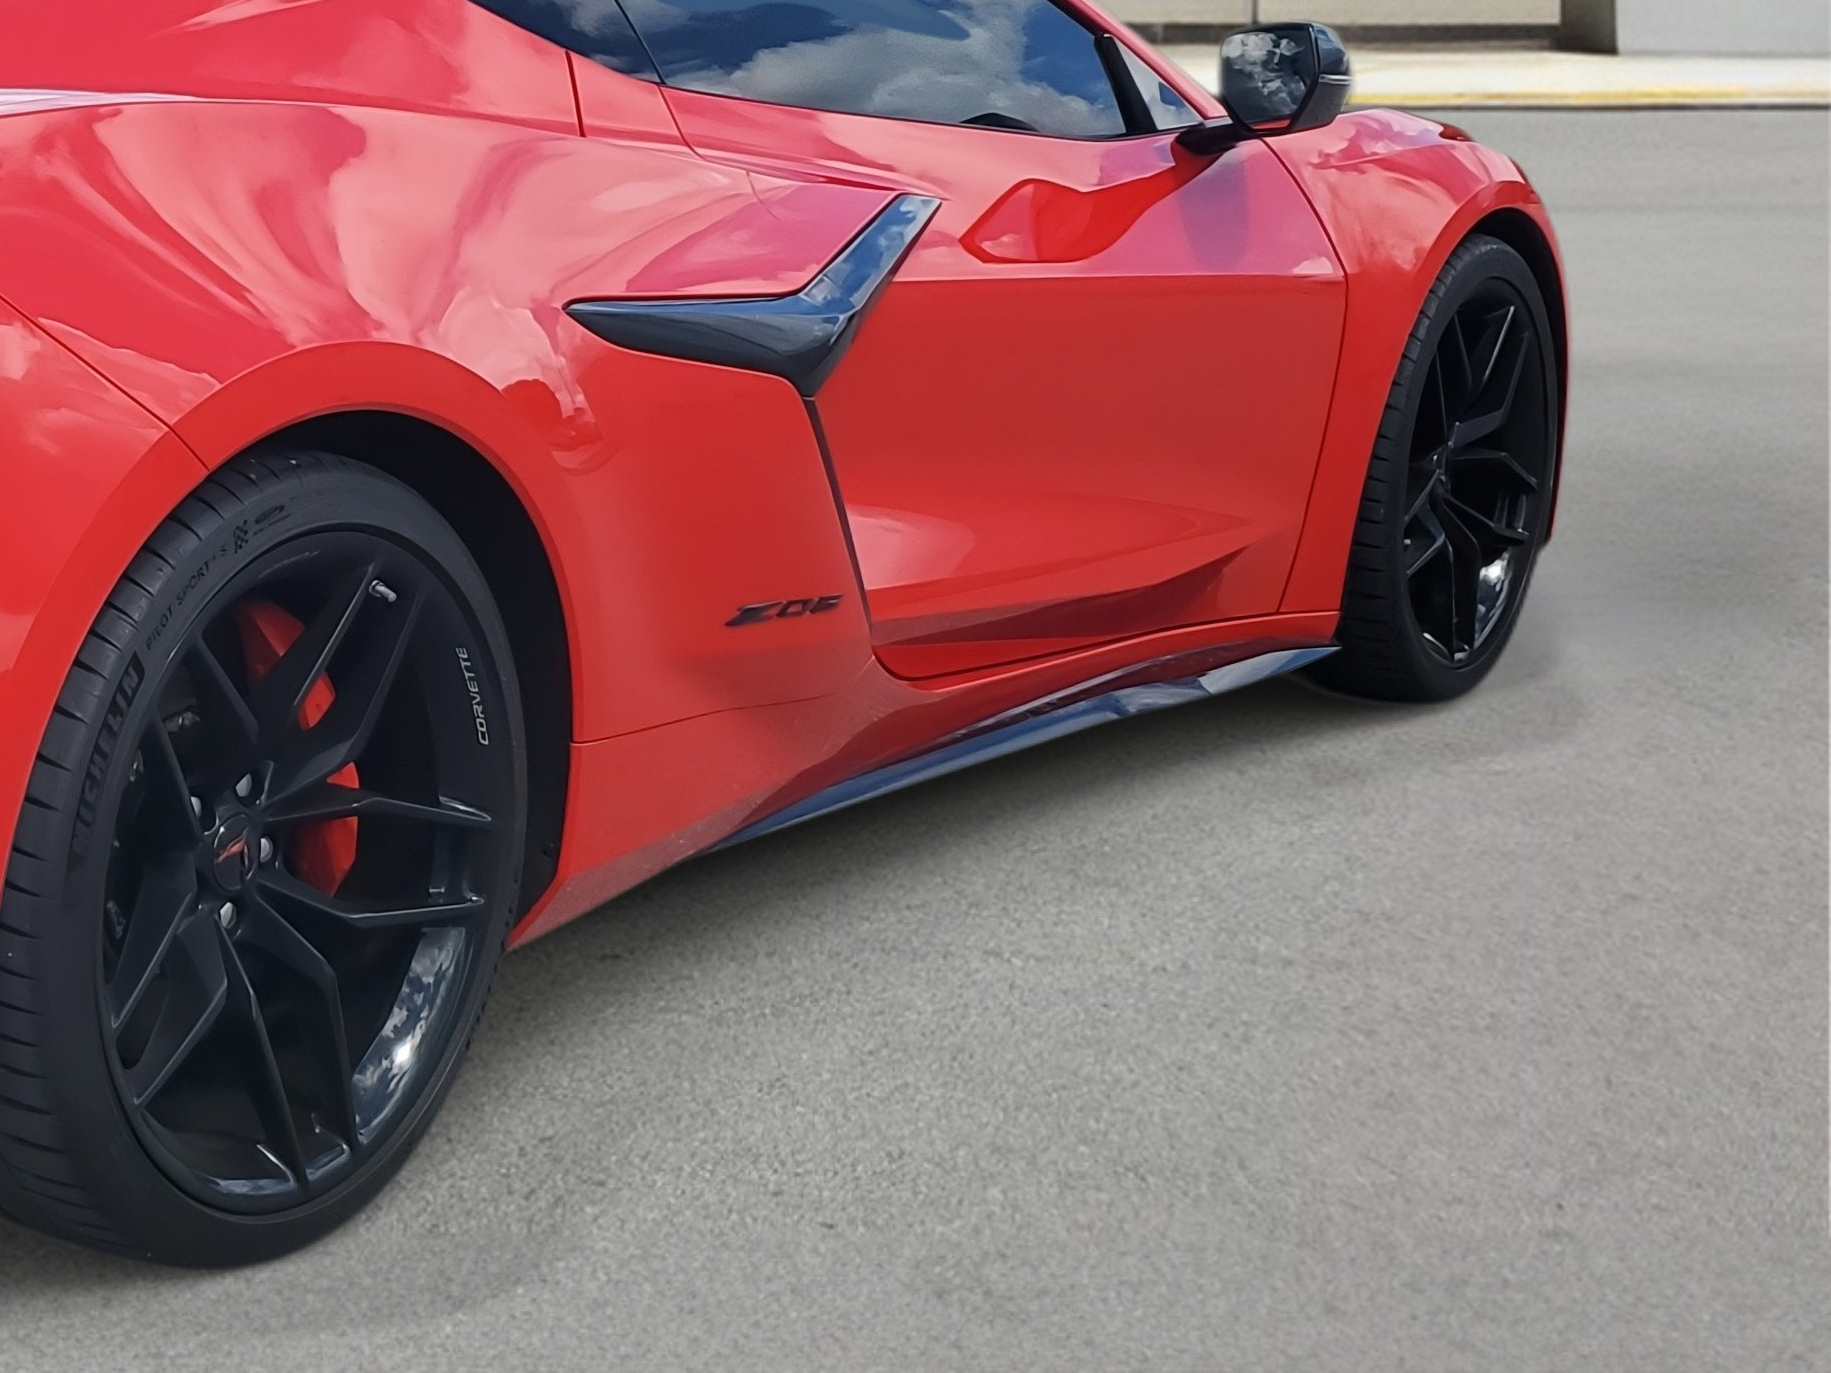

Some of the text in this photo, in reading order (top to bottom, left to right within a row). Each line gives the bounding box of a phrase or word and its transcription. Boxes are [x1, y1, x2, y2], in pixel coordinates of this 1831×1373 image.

[725, 594, 843, 626] Z06
[455, 647, 489, 745] CORVETTE
[71, 665, 139, 857] MICHELIN
